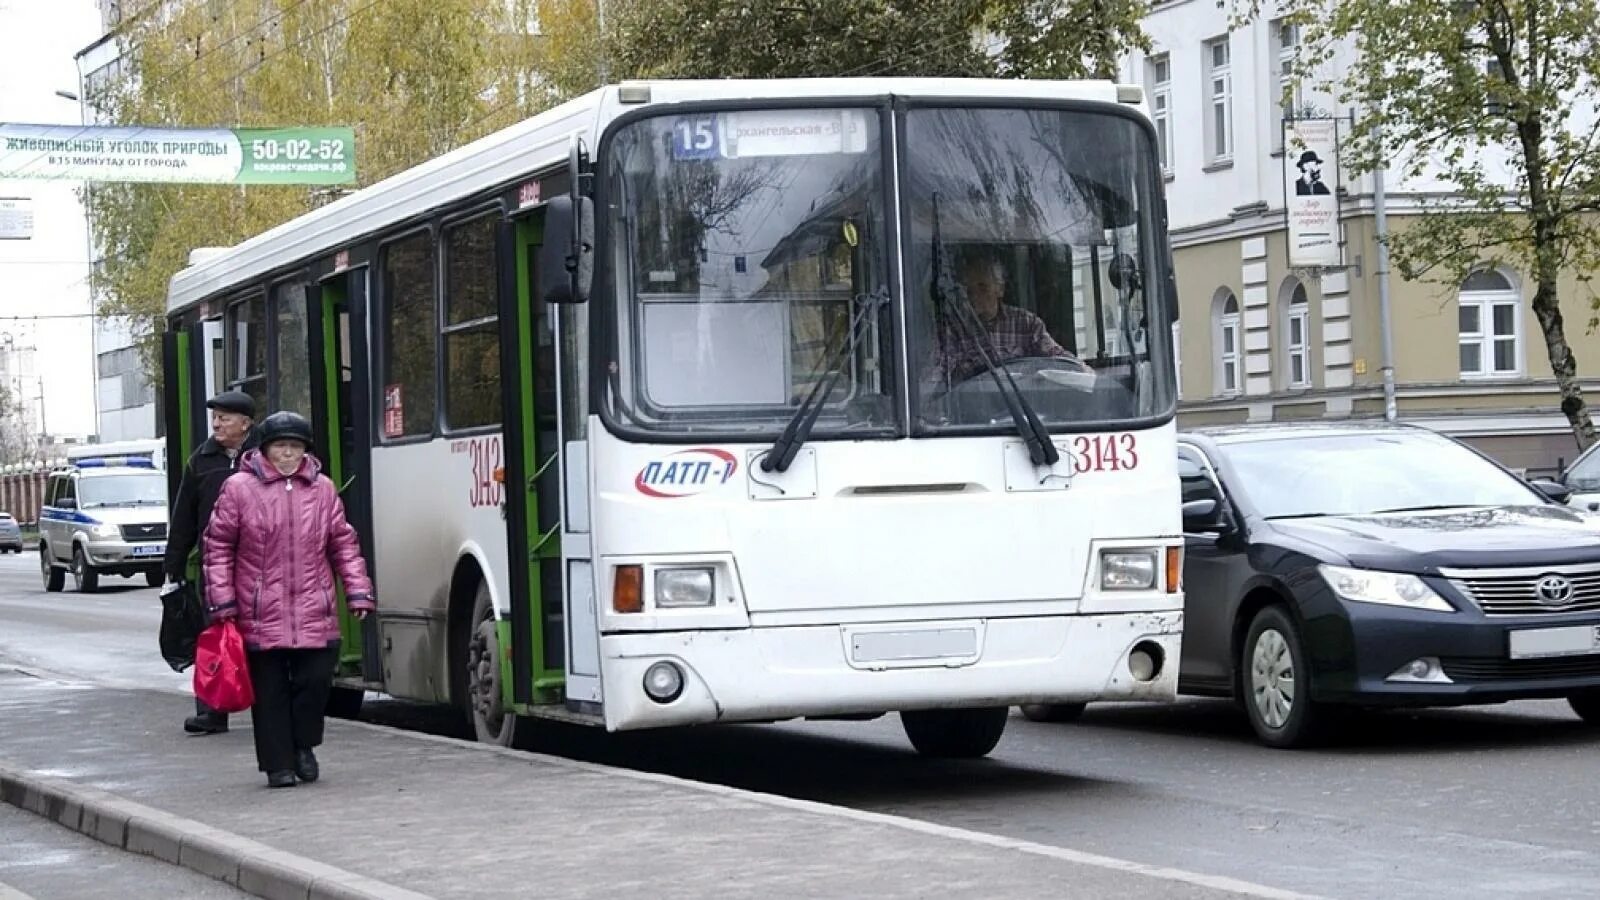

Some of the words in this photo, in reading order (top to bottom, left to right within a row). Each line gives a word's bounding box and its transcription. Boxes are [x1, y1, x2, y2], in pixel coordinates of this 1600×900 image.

[677, 119, 714, 150] 15
[736, 125, 822, 138] рхангельская
[6, 137, 104, 153] ЖИВОПИСНЫЙ
[109, 140, 159, 155] УГОЛОК
[162, 142, 228, 156] ПРИРОДЫ
[252, 139, 345, 160] 50-02-52
[57, 156, 70, 165] 15
[73, 157, 124, 167] МИНУТАХ
[127, 158, 141, 166] ОТ
[144, 159, 188, 168] ГОРОДА
[1074, 433, 1138, 473] 3143
[469, 437, 501, 508] 3143
[643, 461, 732, 484] ПАТП-1
